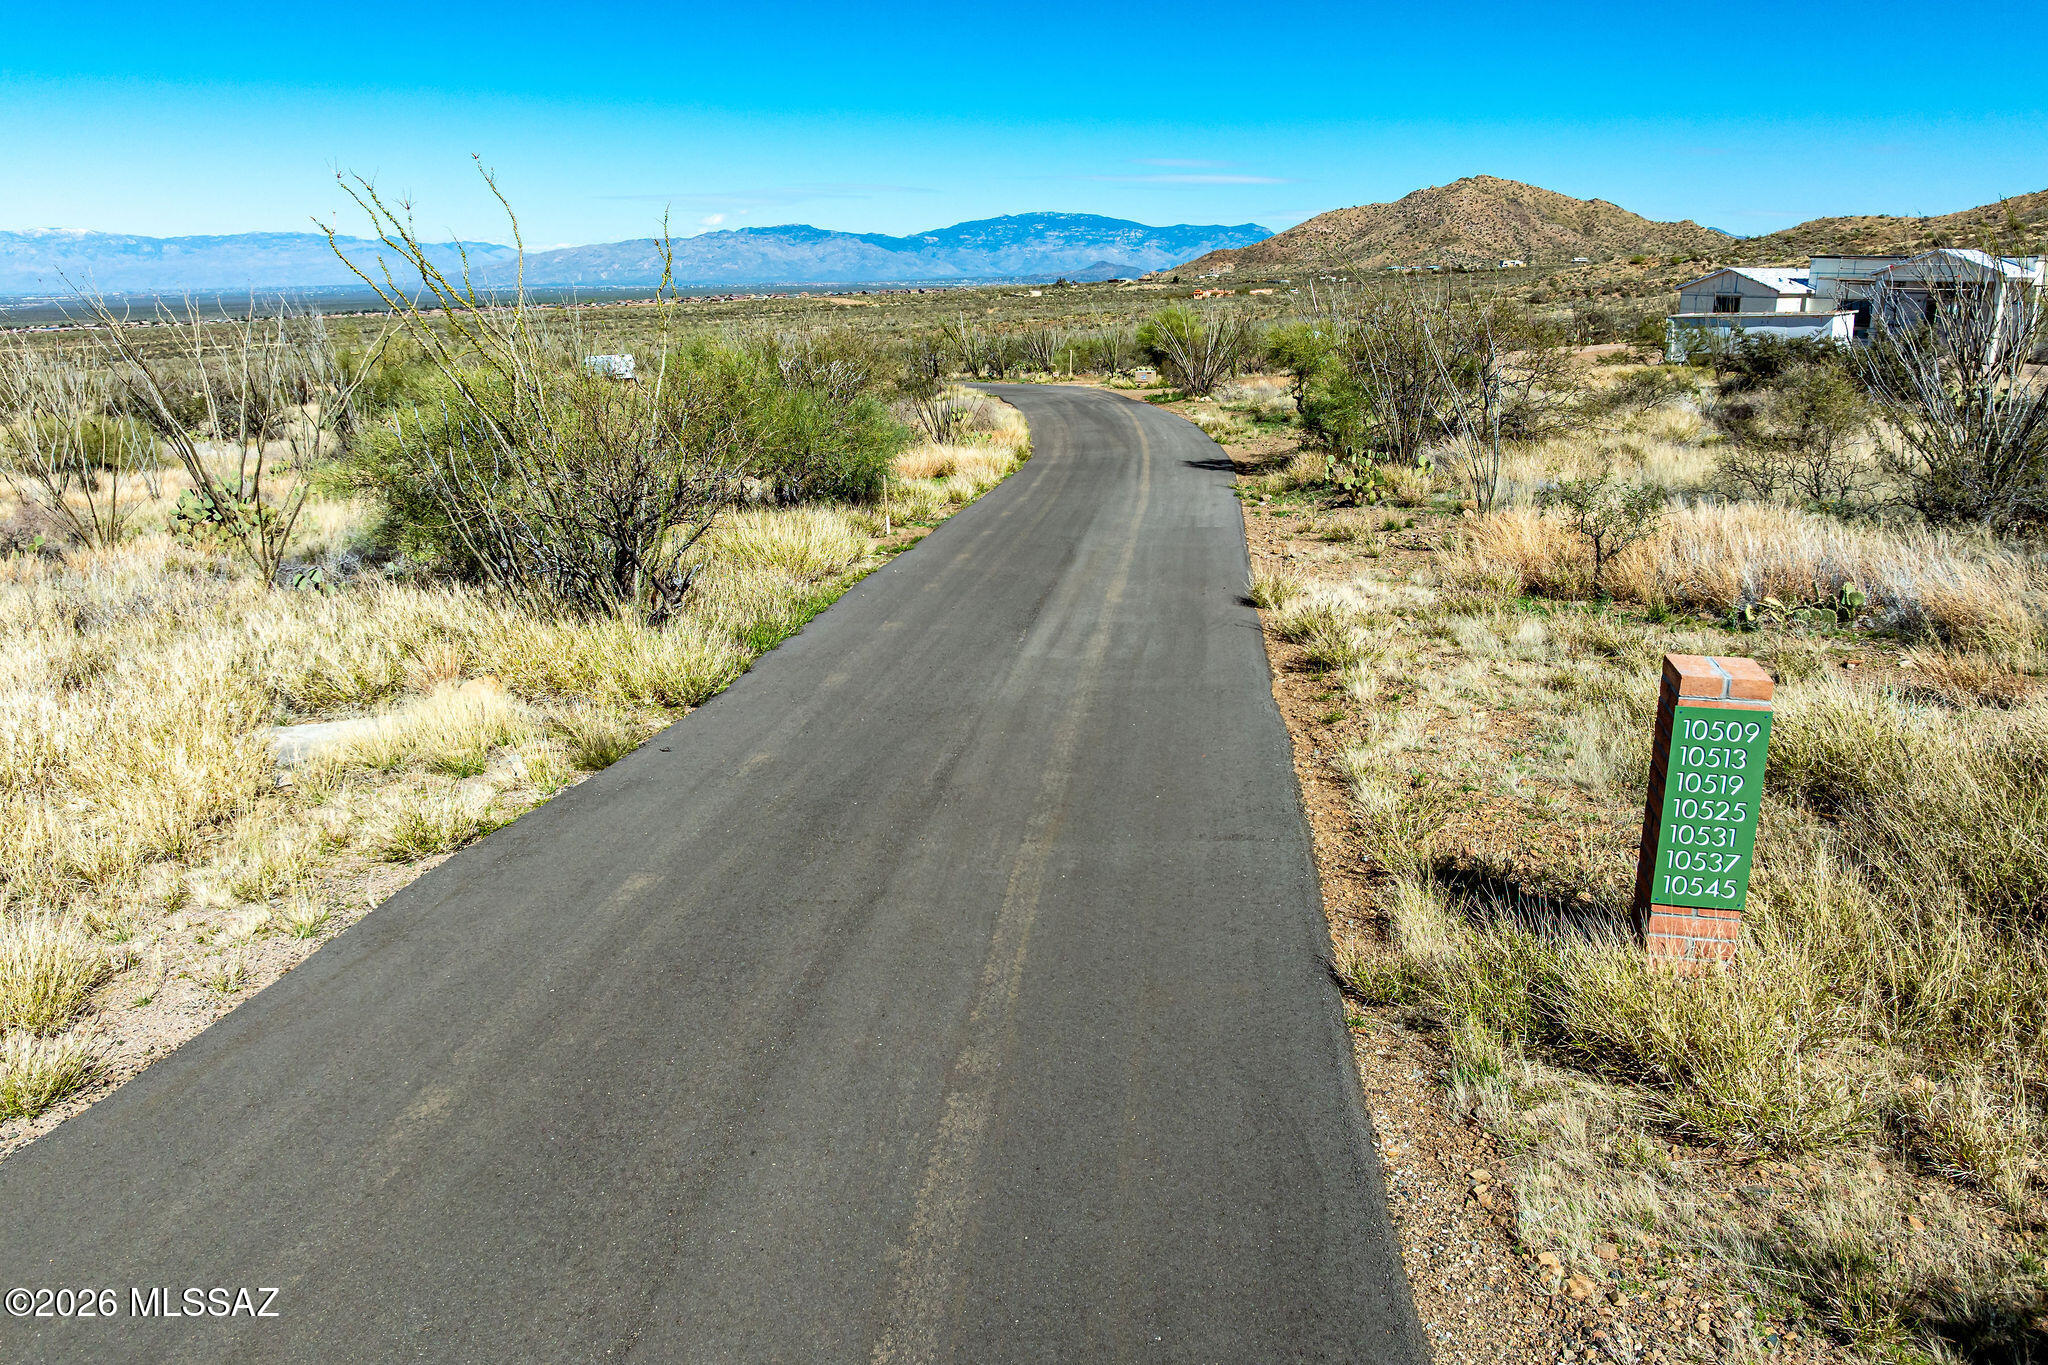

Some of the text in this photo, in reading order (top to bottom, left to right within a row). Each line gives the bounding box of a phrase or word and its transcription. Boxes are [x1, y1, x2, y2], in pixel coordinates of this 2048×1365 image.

[1683, 719, 1761, 744] 10509
[1679, 746, 1747, 770] 10513
[1676, 772, 1744, 796] 10519
[1673, 798, 1747, 823] 10525
[1670, 824, 1736, 848] 10531
[1666, 849, 1742, 874] 10537
[1663, 874, 1737, 899] 10545
